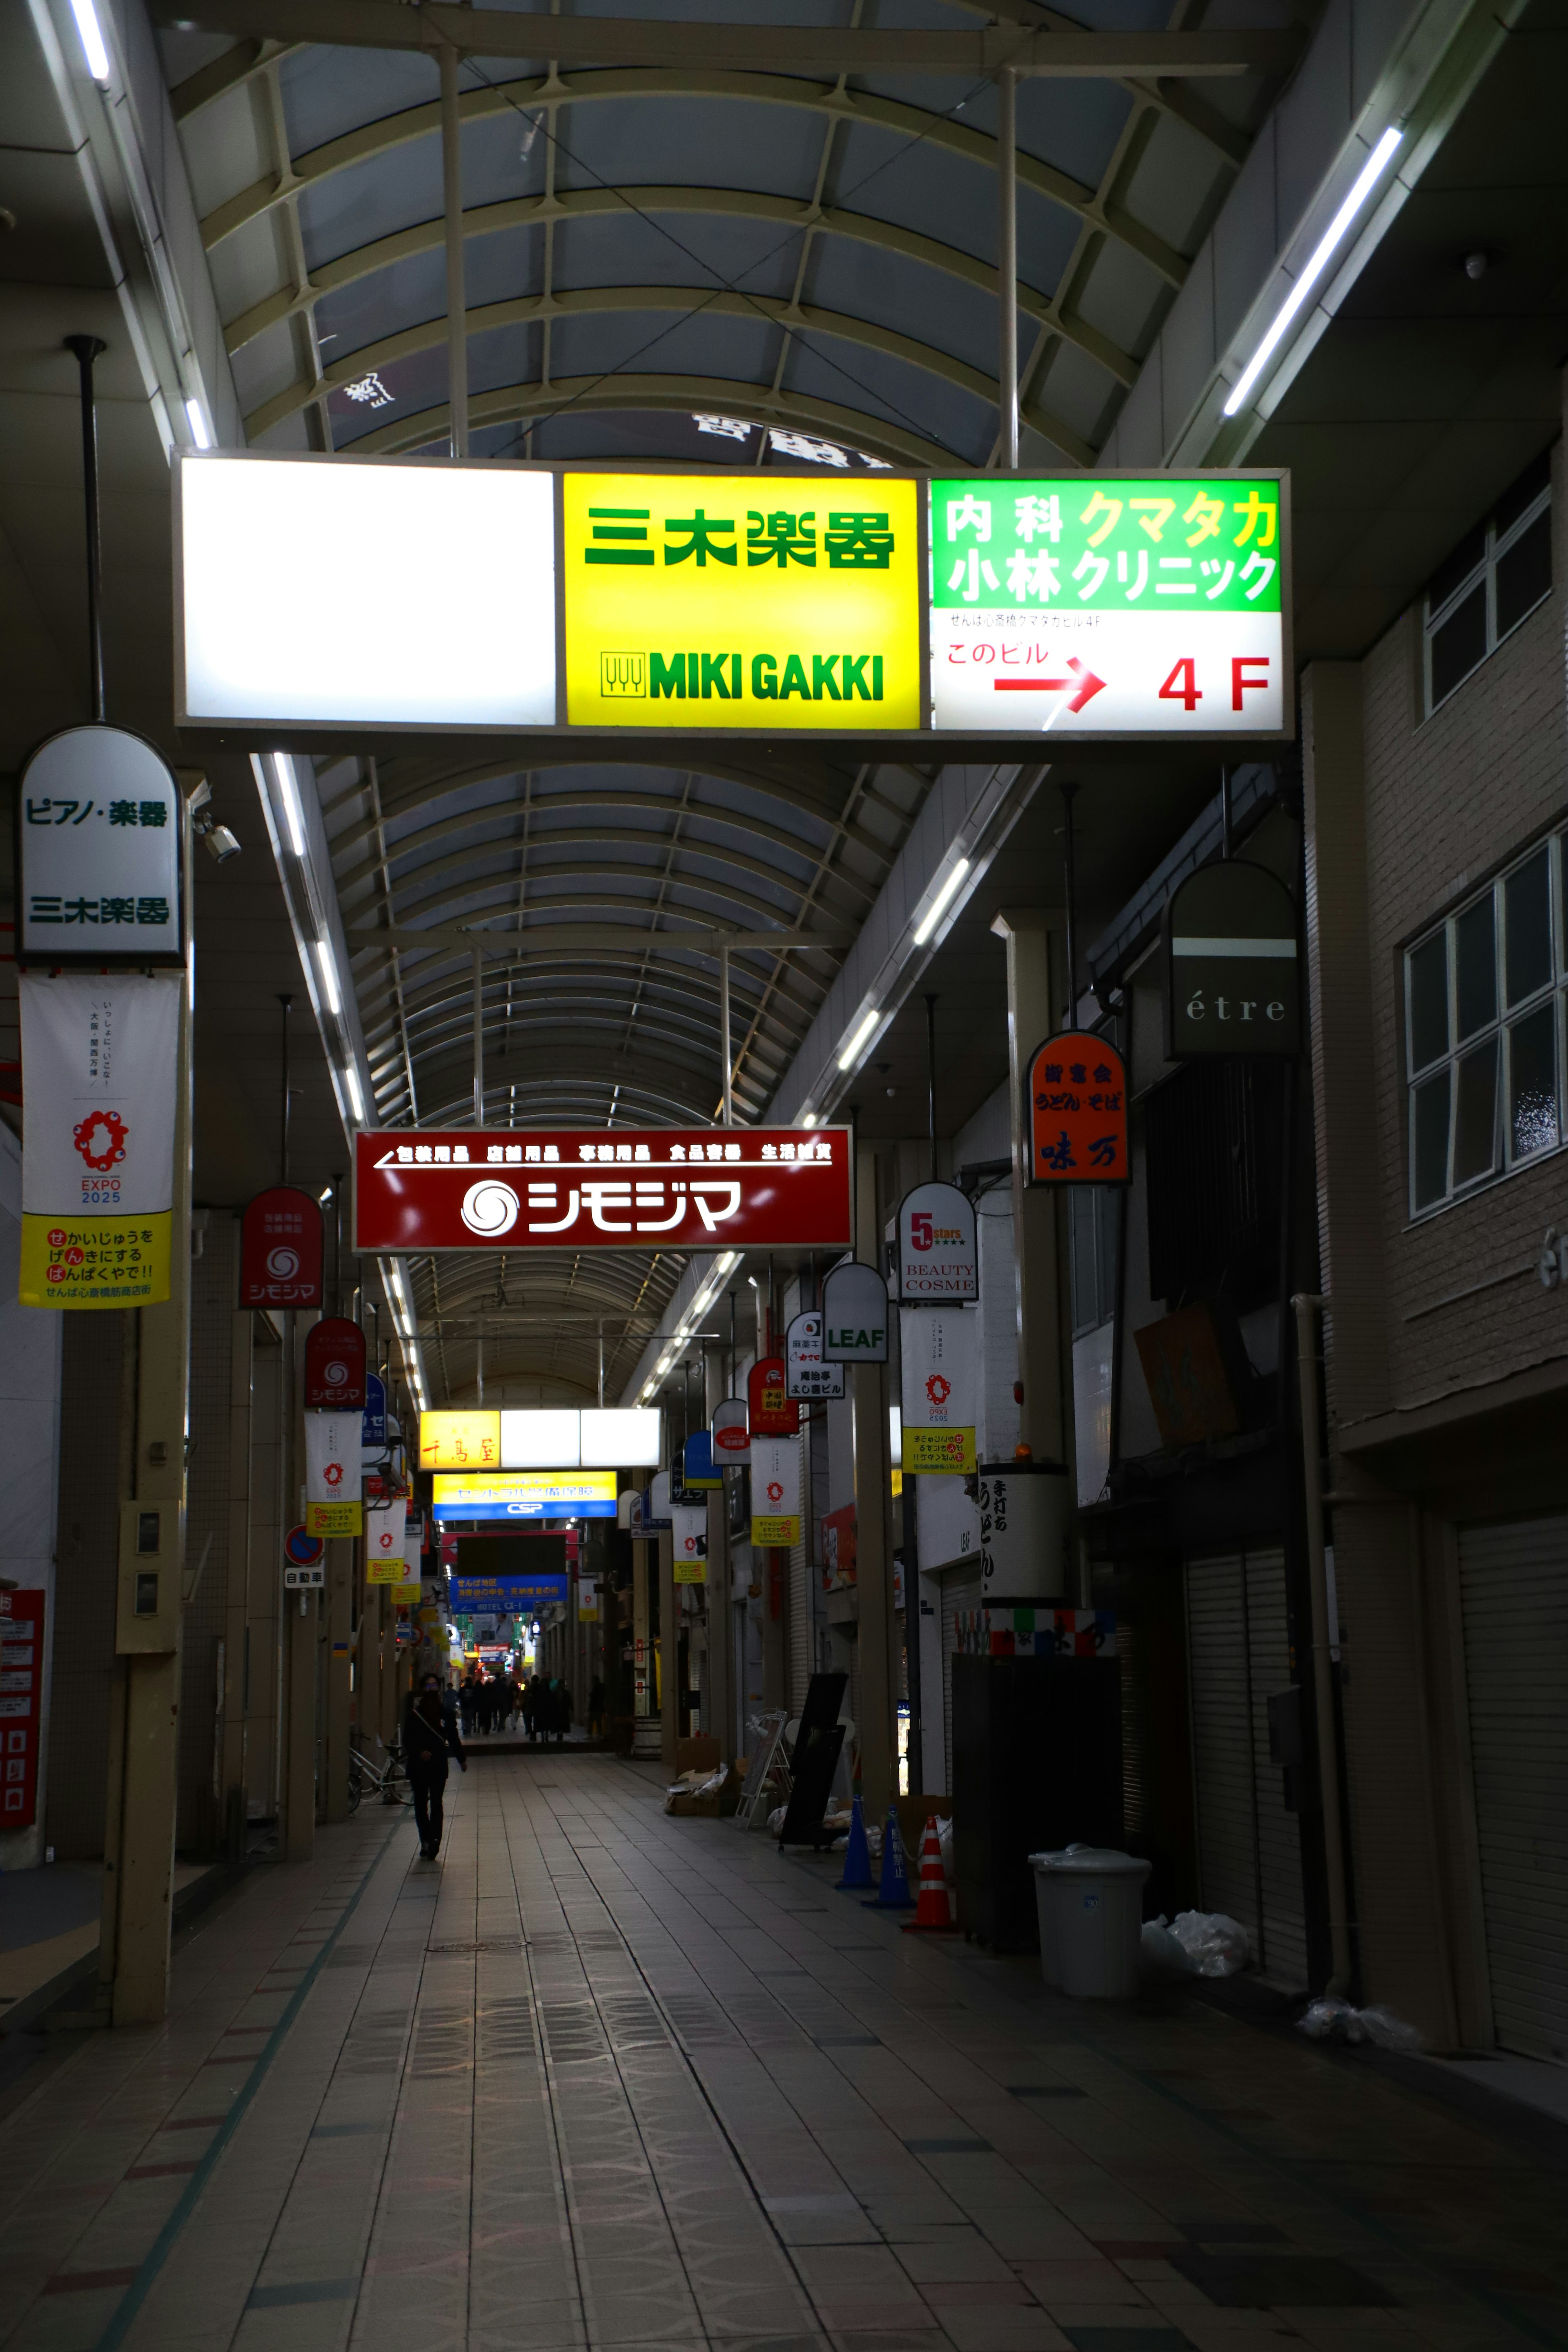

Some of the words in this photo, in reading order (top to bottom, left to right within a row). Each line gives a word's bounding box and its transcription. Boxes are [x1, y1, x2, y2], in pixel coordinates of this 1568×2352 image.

[585, 508, 895, 569] 三木楽器
[949, 641, 1049, 664] このビル
[649, 652, 742, 699] MIKI
[751, 653, 883, 701] GAKKI
[26, 798, 167, 827] ピアノ・楽器
[29, 896, 169, 924] 三木楽器
[1187, 990, 1285, 1021] étre
[396, 1145, 469, 1163] 包装用品
[487, 1145, 559, 1162] 店舗用品
[579, 1144, 650, 1162] 事務用品
[670, 1144, 741, 1161] 食品容器
[761, 1143, 832, 1160] 生活雑貨
[82, 1180, 120, 1191] EXPO
[82, 1192, 120, 1203] 2025
[528, 1181, 740, 1232] シモジマ
[48, 1229, 153, 1246] せかいじゅうを
[911, 1213, 933, 1251] 5
[933, 1228, 961, 1238] stars
[49, 1248, 142, 1263] げんきにする
[906, 1265, 974, 1275] BEAUTY
[249, 1284, 315, 1300] シモジマ
[906, 1280, 974, 1291] COSME
[828, 1329, 885, 1349] LEAF
[312, 1389, 360, 1401] シモジマ
[422, 1438, 495, 1463] 千鳥屋
[508, 1504, 542, 1513] CSP
[993, 1480, 1007, 1531] 手打ち
[287, 1572, 322, 1583] 自動車
